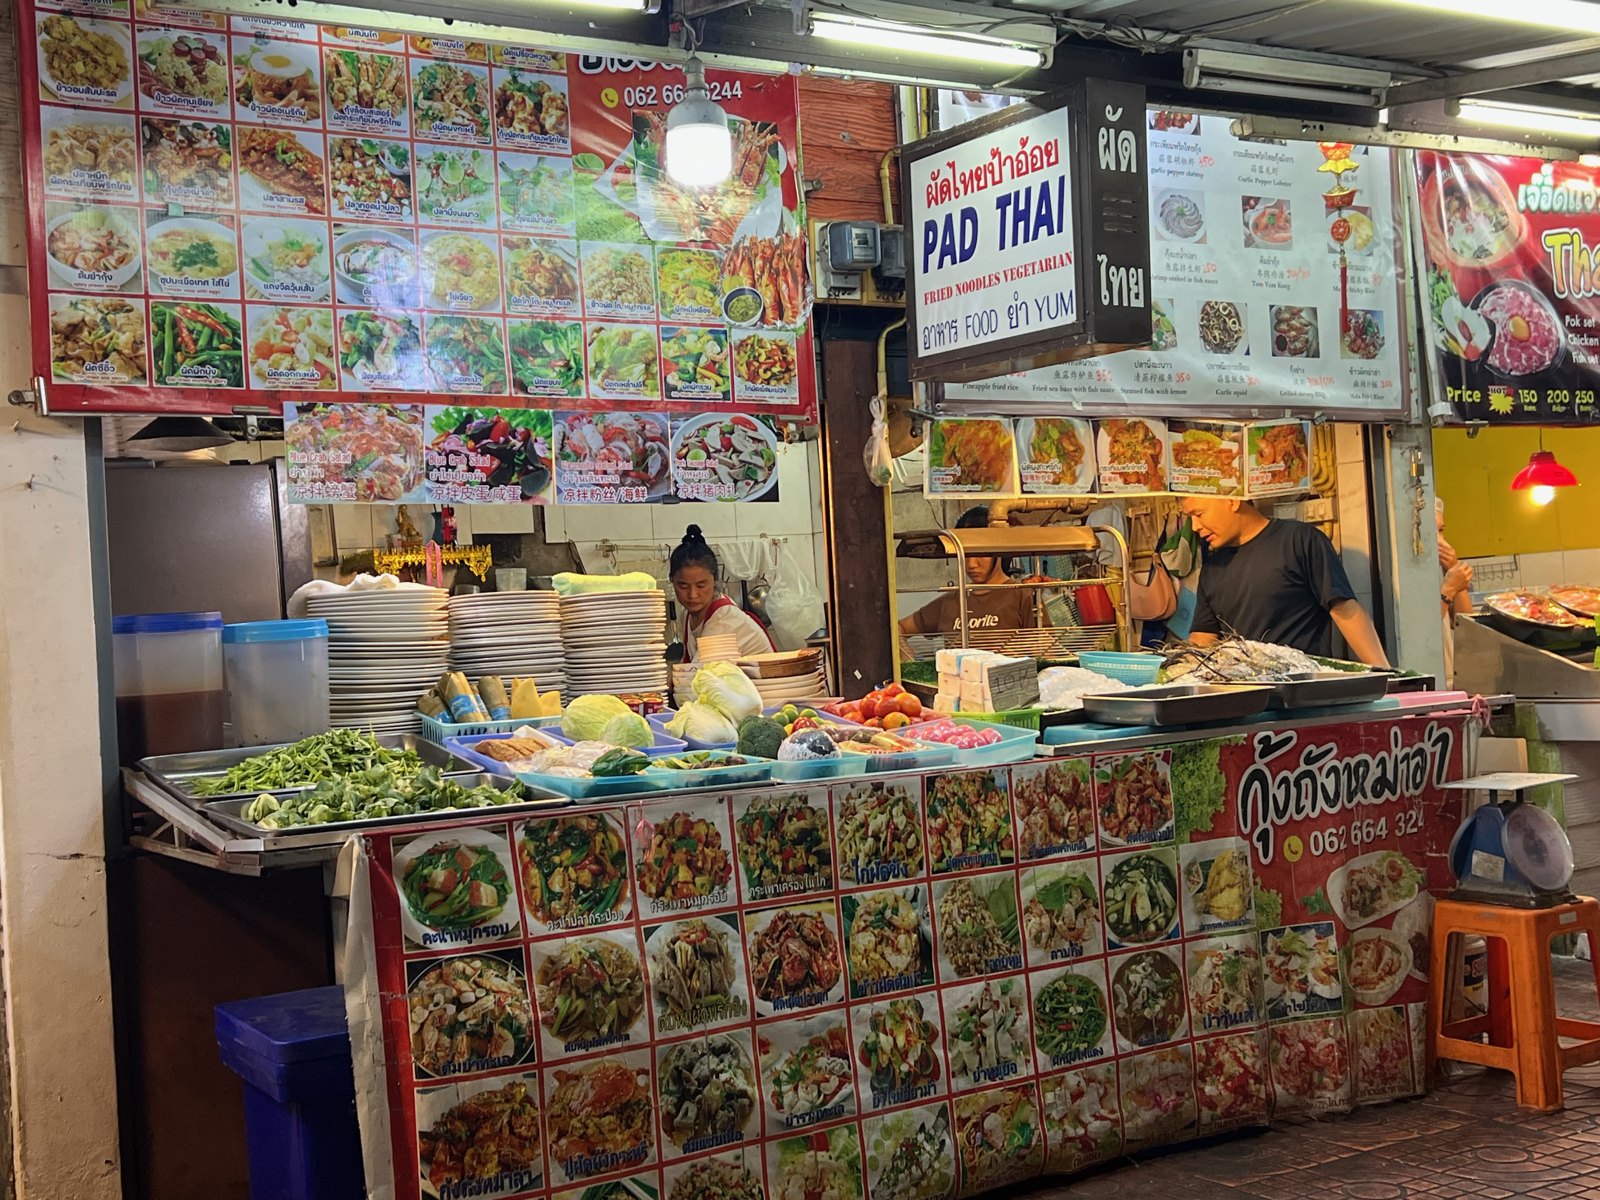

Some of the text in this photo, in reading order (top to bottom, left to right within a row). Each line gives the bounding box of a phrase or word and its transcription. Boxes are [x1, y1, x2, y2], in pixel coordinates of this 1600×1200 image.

[624, 87, 657, 107] 062
[662, 84, 684, 104] 66
[1098, 104, 1137, 173] ผัด
[926, 136, 1059, 208] ผัดไทยป้าอ้อย
[923, 175, 1065, 274] PAD THAI
[1542, 227, 1600, 299] Tha
[924, 251, 1073, 306] FRIED NOODLES VEGETARIAN
[1096, 254, 1144, 308] ไทย
[1151, 274, 1167, 282] hrimp
[923, 289, 1074, 350] อาหาร FOOD ยำ YUM
[1565, 315, 1595, 328] Pok set
[1568, 334, 1598, 346] Chicken
[1447, 385, 1481, 403] Price
[1518, 390, 1537, 403] 150
[1547, 390, 1569, 403] 200
[1575, 390, 1594, 403] 250
[310, 452, 327, 464] Crab
[330, 451, 352, 463] Salad
[429, 454, 490, 467] Blue Crab Salad
[1350, 817, 1388, 846] 664
[422, 922, 510, 946] คะน้าหมูกรอบ
